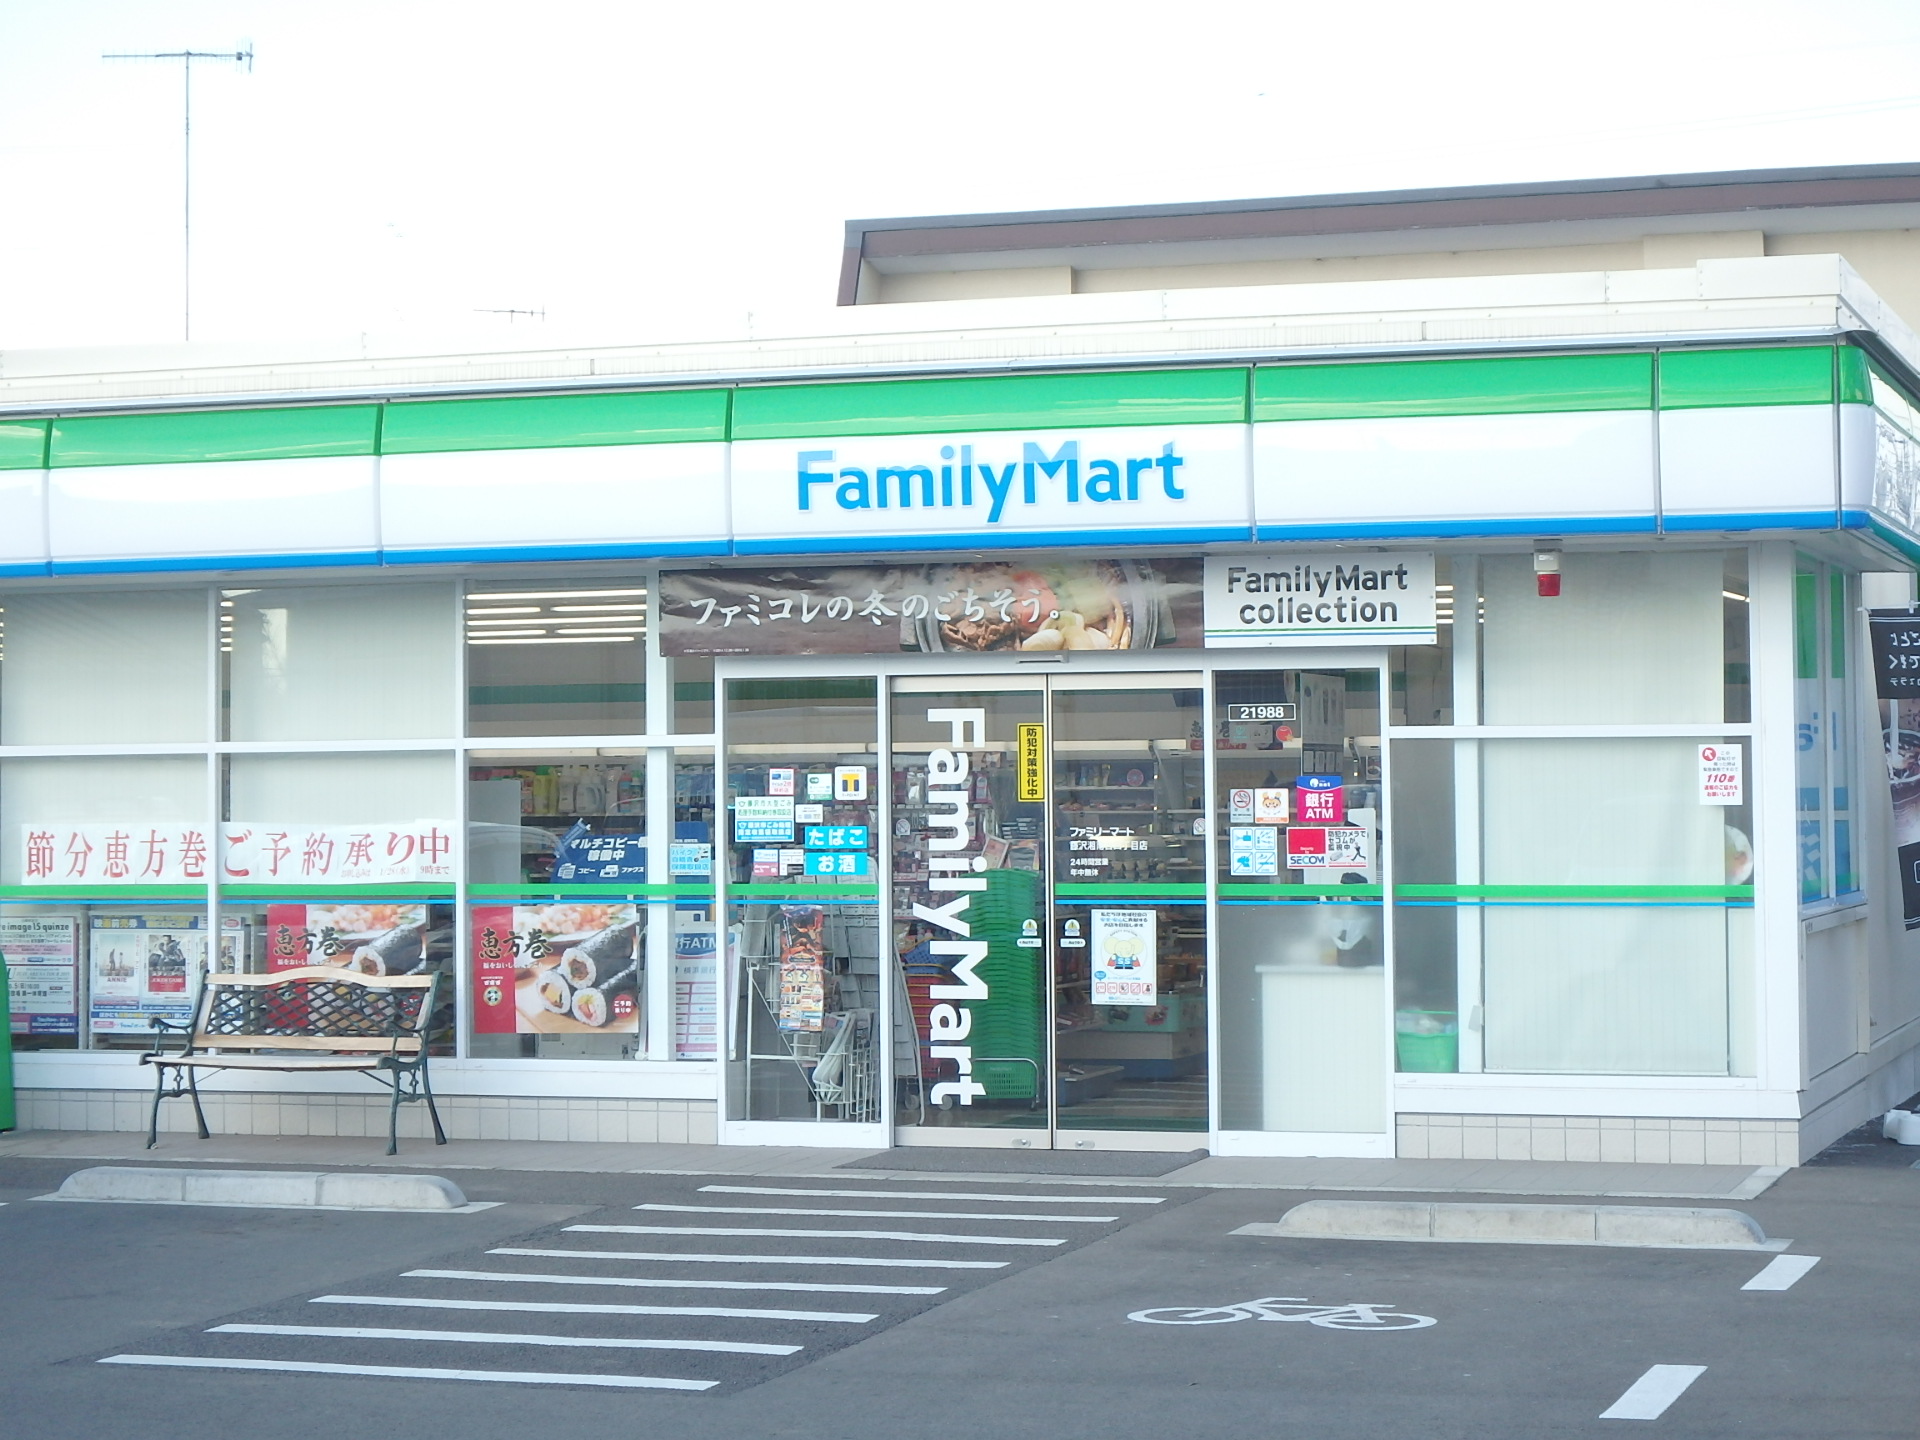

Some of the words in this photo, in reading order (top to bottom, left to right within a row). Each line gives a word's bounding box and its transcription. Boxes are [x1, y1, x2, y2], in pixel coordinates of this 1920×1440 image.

[797, 440, 1184, 523] FamilyMart
[1227, 563, 1408, 598] FamilyMart
[688, 587, 1061, 627] ファミコレの冬のごちそう。
[1239, 596, 1398, 625] collection
[1240, 706, 1285, 719] 21988
[1025, 727, 1039, 798] 防犯対策強化中
[1707, 773, 1735, 783] 110番
[1305, 793, 1334, 807] 銀行
[1305, 808, 1333, 819] ATM
[808, 828, 864, 846] たばこ
[1070, 827, 1135, 837] ファミリーマート
[26, 826, 450, 878] 節分恵方巻ご予約承り中
[1290, 855, 1325, 865] SECOM
[420, 865, 450, 875] 9時まで
[817, 855, 856, 873] お酒
[912, 708, 989, 1106] FamilyMart
[7, 923, 31, 932] image
[42, 923, 69, 932] quinze
[274, 925, 346, 956] 恵方巻
[479, 927, 553, 959] 恵方巻
